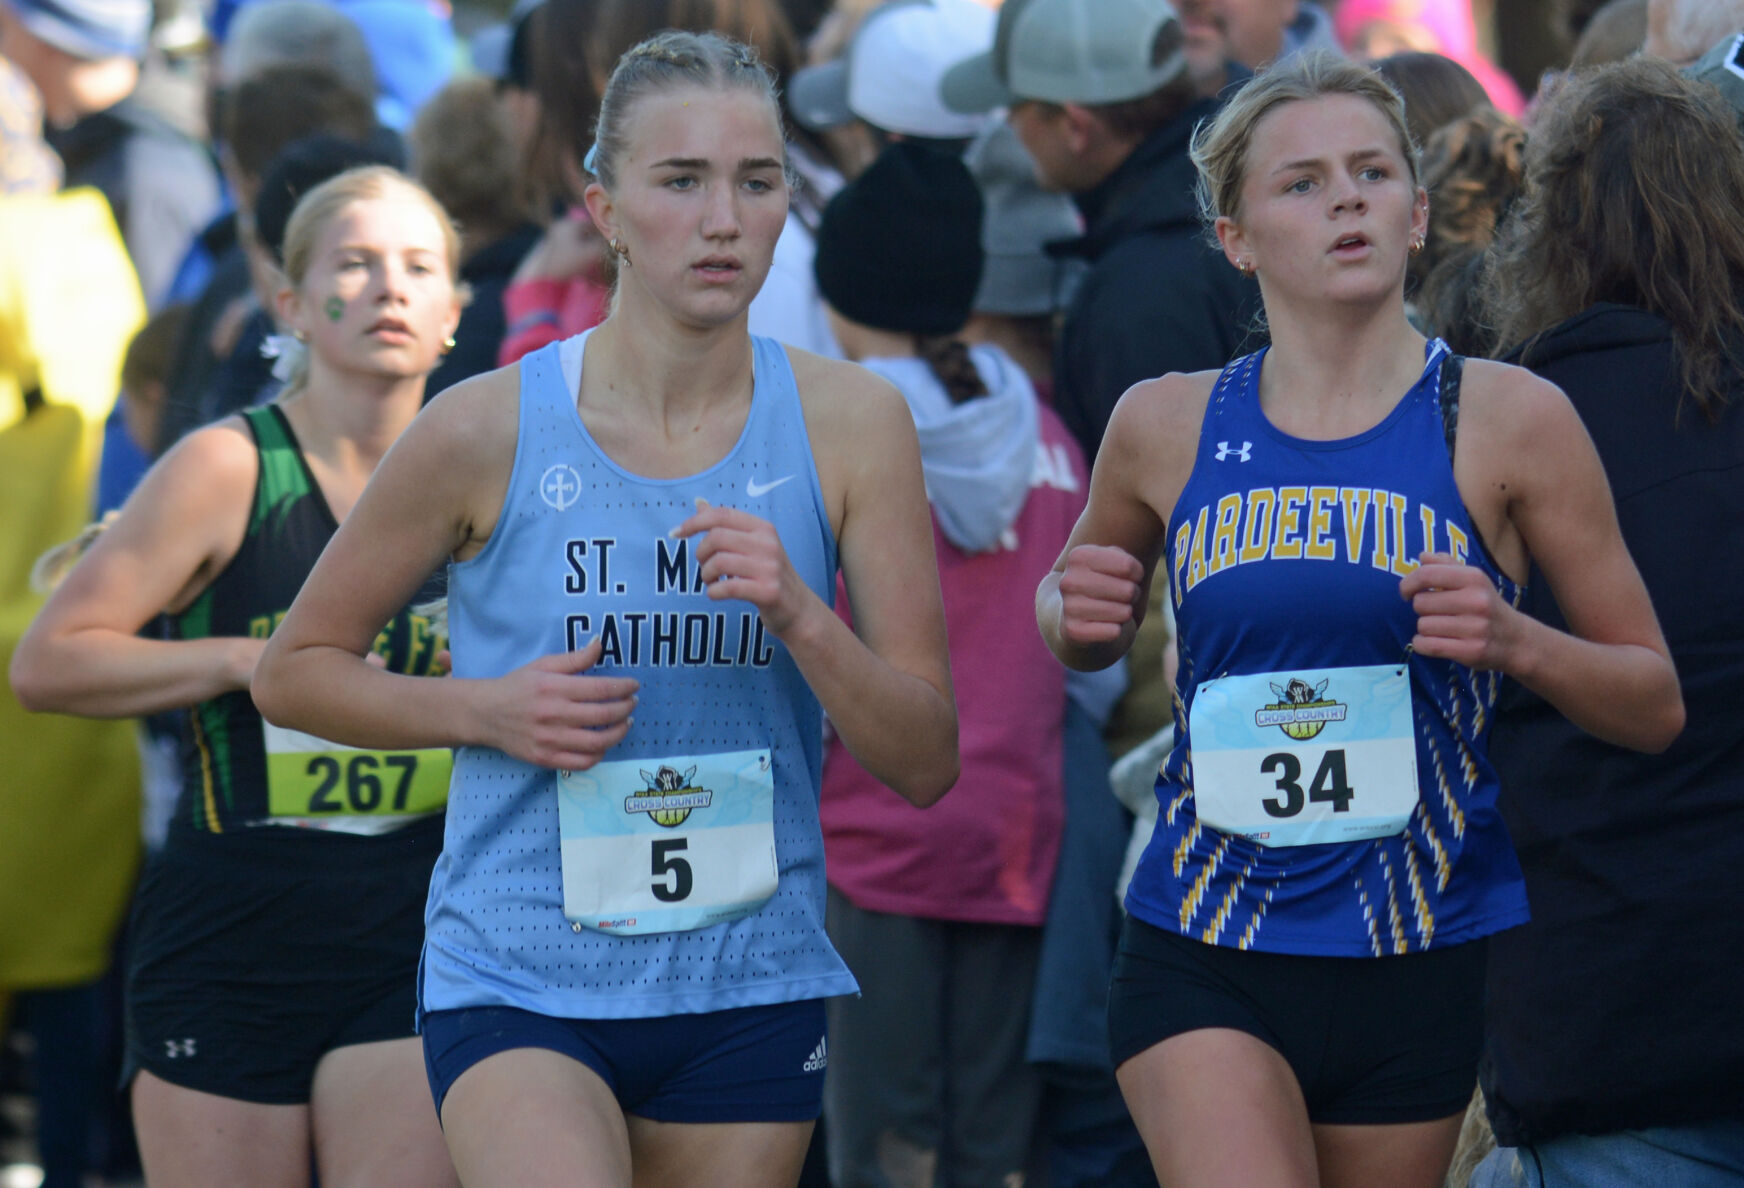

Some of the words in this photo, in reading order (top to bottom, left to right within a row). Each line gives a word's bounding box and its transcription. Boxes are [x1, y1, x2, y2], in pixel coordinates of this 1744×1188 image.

[564, 537, 628, 596] ST.
[565, 611, 775, 669] CATHOLIC
[1257, 710, 1293, 724] CROSS
[1295, 706, 1344, 721] COUNTRY
[307, 754, 418, 813] 267
[627, 797, 662, 811] CROSS
[664, 793, 709, 808] COUNTRY
[1260, 748, 1355, 819] 34
[650, 837, 693, 903] 5
